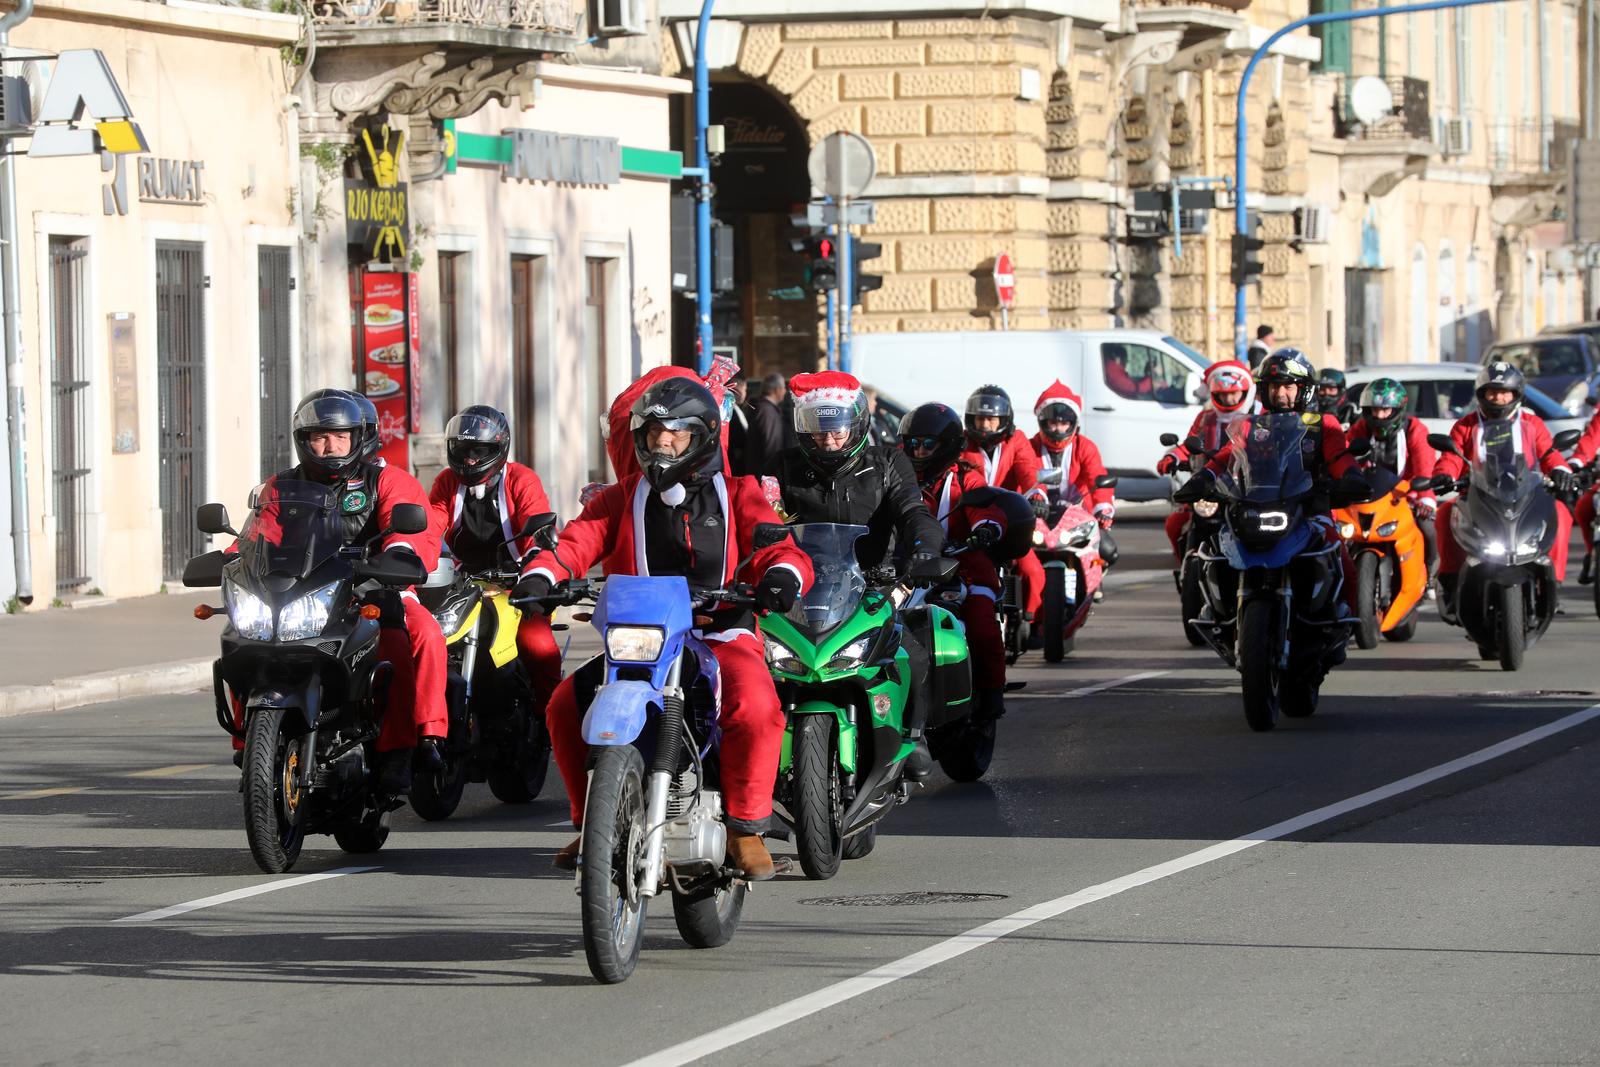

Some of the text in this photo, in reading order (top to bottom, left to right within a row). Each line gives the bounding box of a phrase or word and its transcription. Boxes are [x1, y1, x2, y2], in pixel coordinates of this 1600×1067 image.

[723, 116, 785, 145] Fidelio
[137, 156, 205, 201] RUMAT
[370, 189, 405, 227] KEBAB
[816, 408, 837, 416] SHOEI
